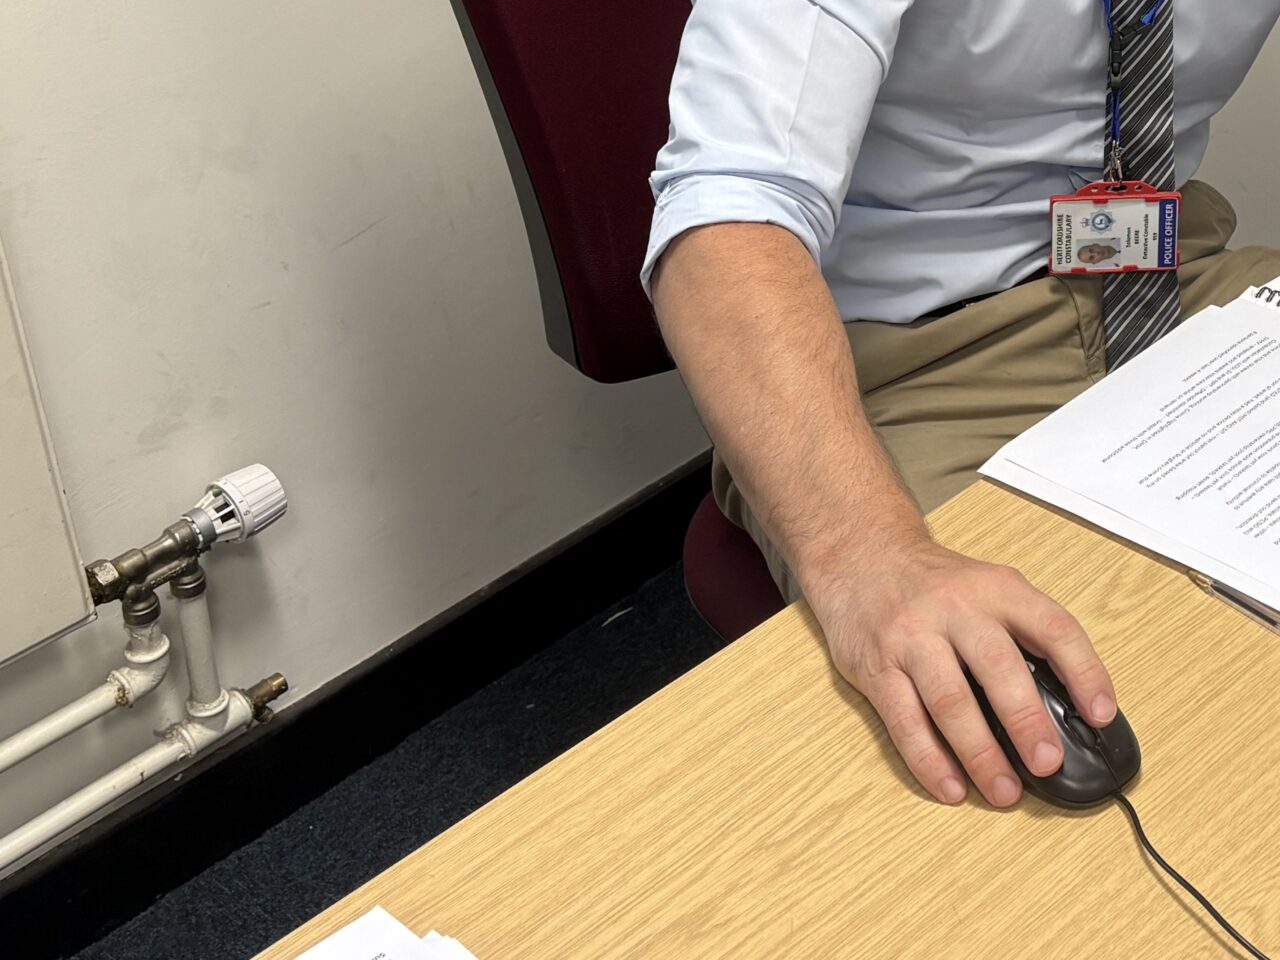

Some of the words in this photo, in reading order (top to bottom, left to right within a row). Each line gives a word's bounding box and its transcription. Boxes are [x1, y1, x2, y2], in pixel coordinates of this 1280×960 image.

[1056, 214, 1064, 265] HERTFORDSHIRE
[1065, 214, 1073, 263] CONSTABULARY
[1165, 203, 1174, 236] OFFICER
[1164, 237, 1172, 264] POLICE
